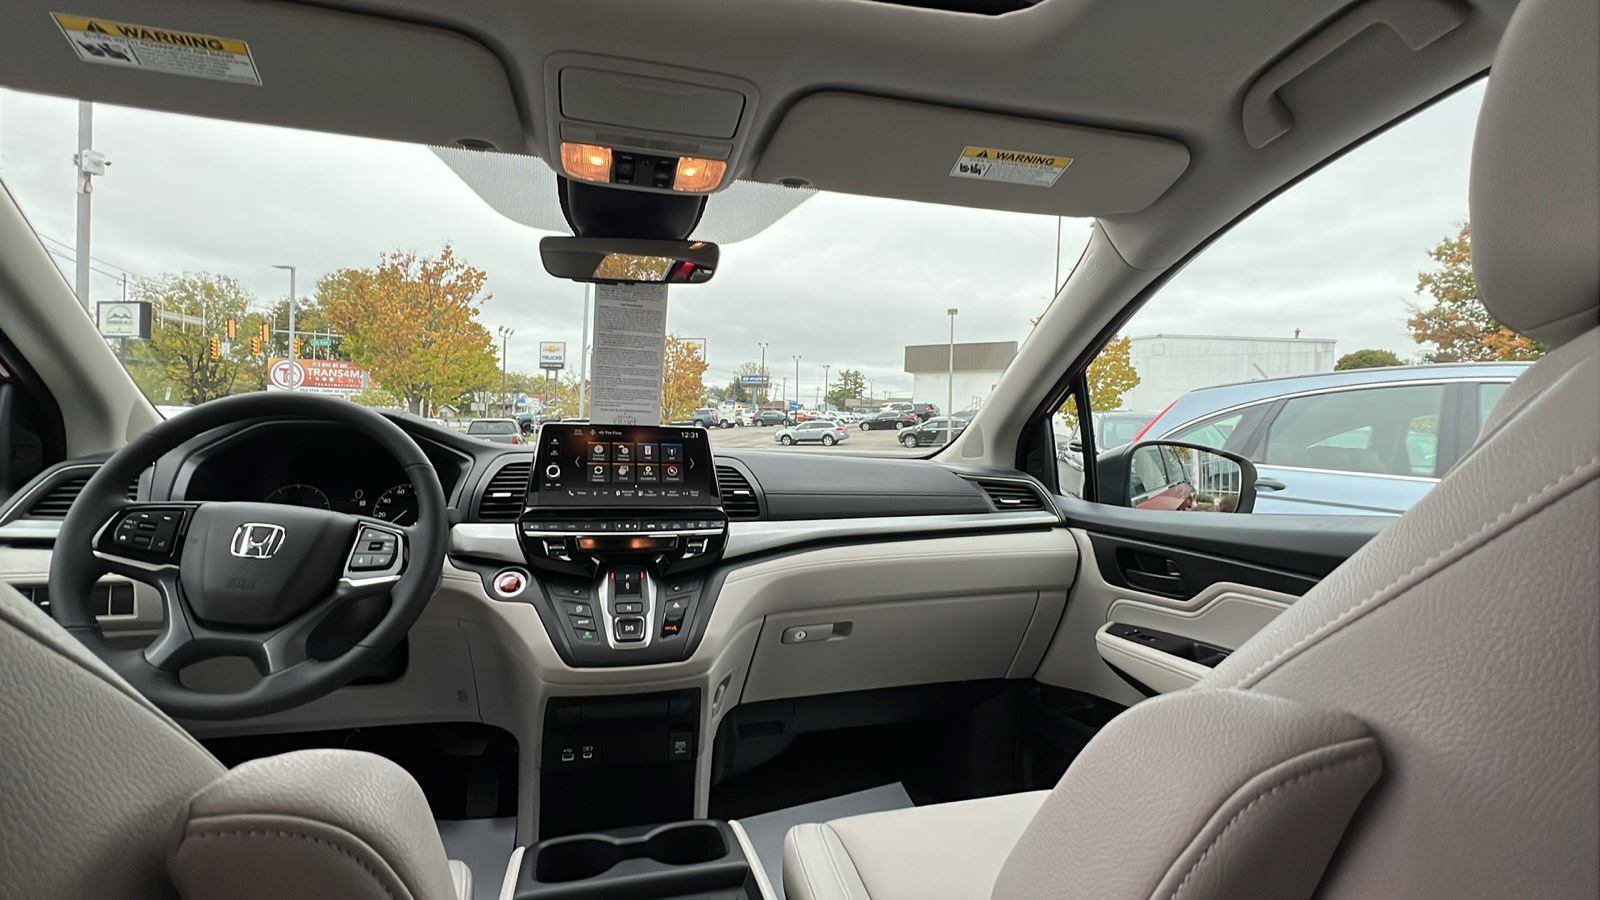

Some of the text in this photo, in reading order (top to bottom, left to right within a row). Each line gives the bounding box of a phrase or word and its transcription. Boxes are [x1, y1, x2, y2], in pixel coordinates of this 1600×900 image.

[116, 25, 225, 51] WARNING
[996, 151, 1056, 166] WARNING
[681, 431, 699, 439] 12:31
